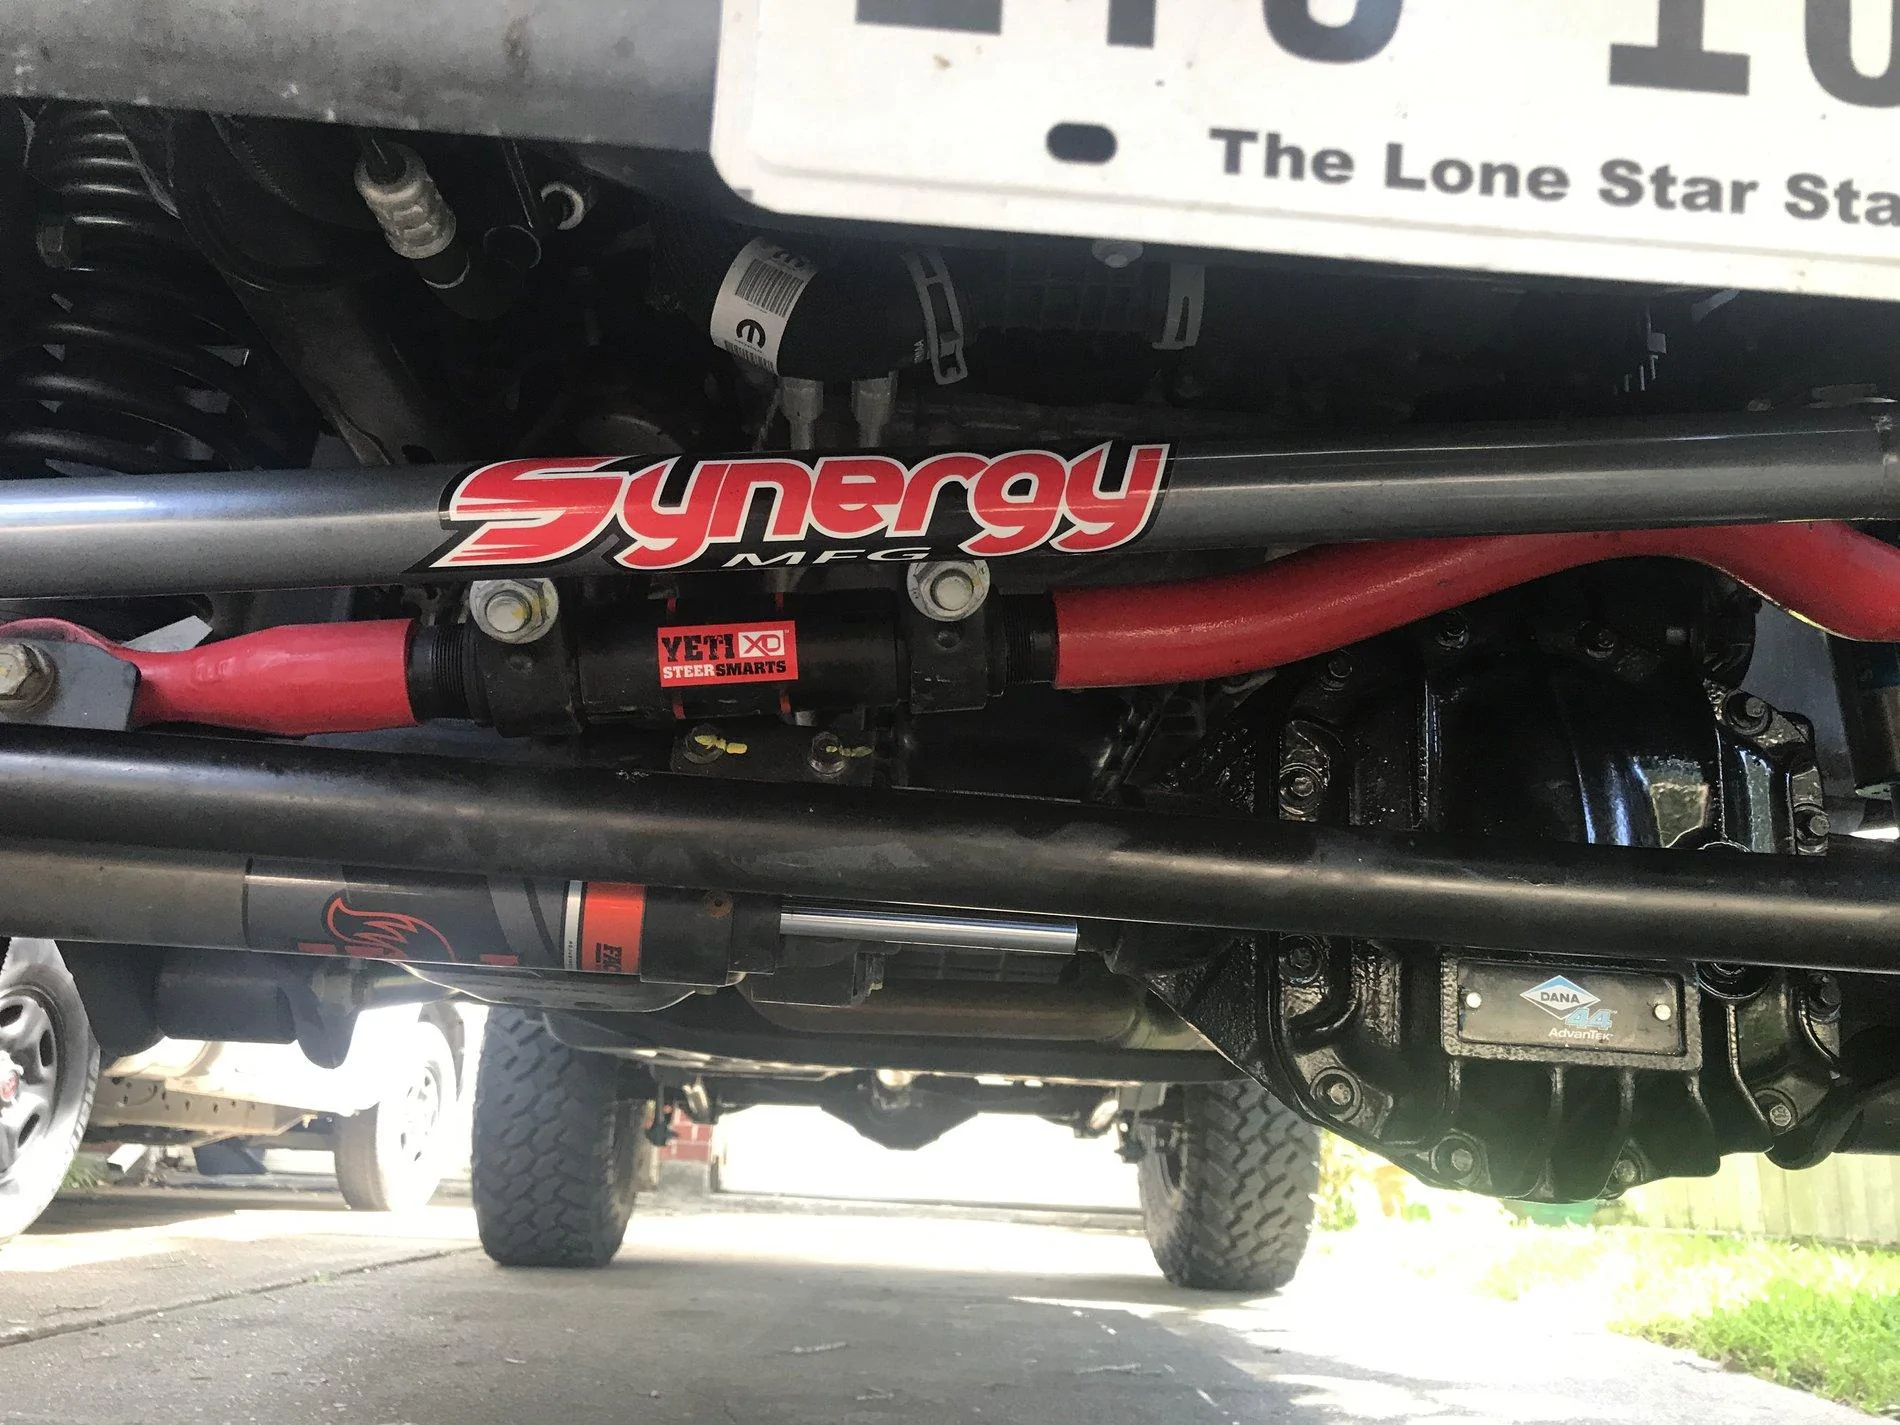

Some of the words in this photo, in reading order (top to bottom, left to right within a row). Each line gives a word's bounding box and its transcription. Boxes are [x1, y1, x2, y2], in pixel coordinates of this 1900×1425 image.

[1208, 126, 1354, 185] The
[1384, 141, 1571, 203] Lone
[1598, 157, 1760, 215] Star
[429, 442, 1172, 570] Synergy
[720, 546, 932, 568] MFG
[661, 633, 735, 662] YETI
[1540, 991, 1580, 1004] DANA
[1564, 1006, 1613, 1030] 44
